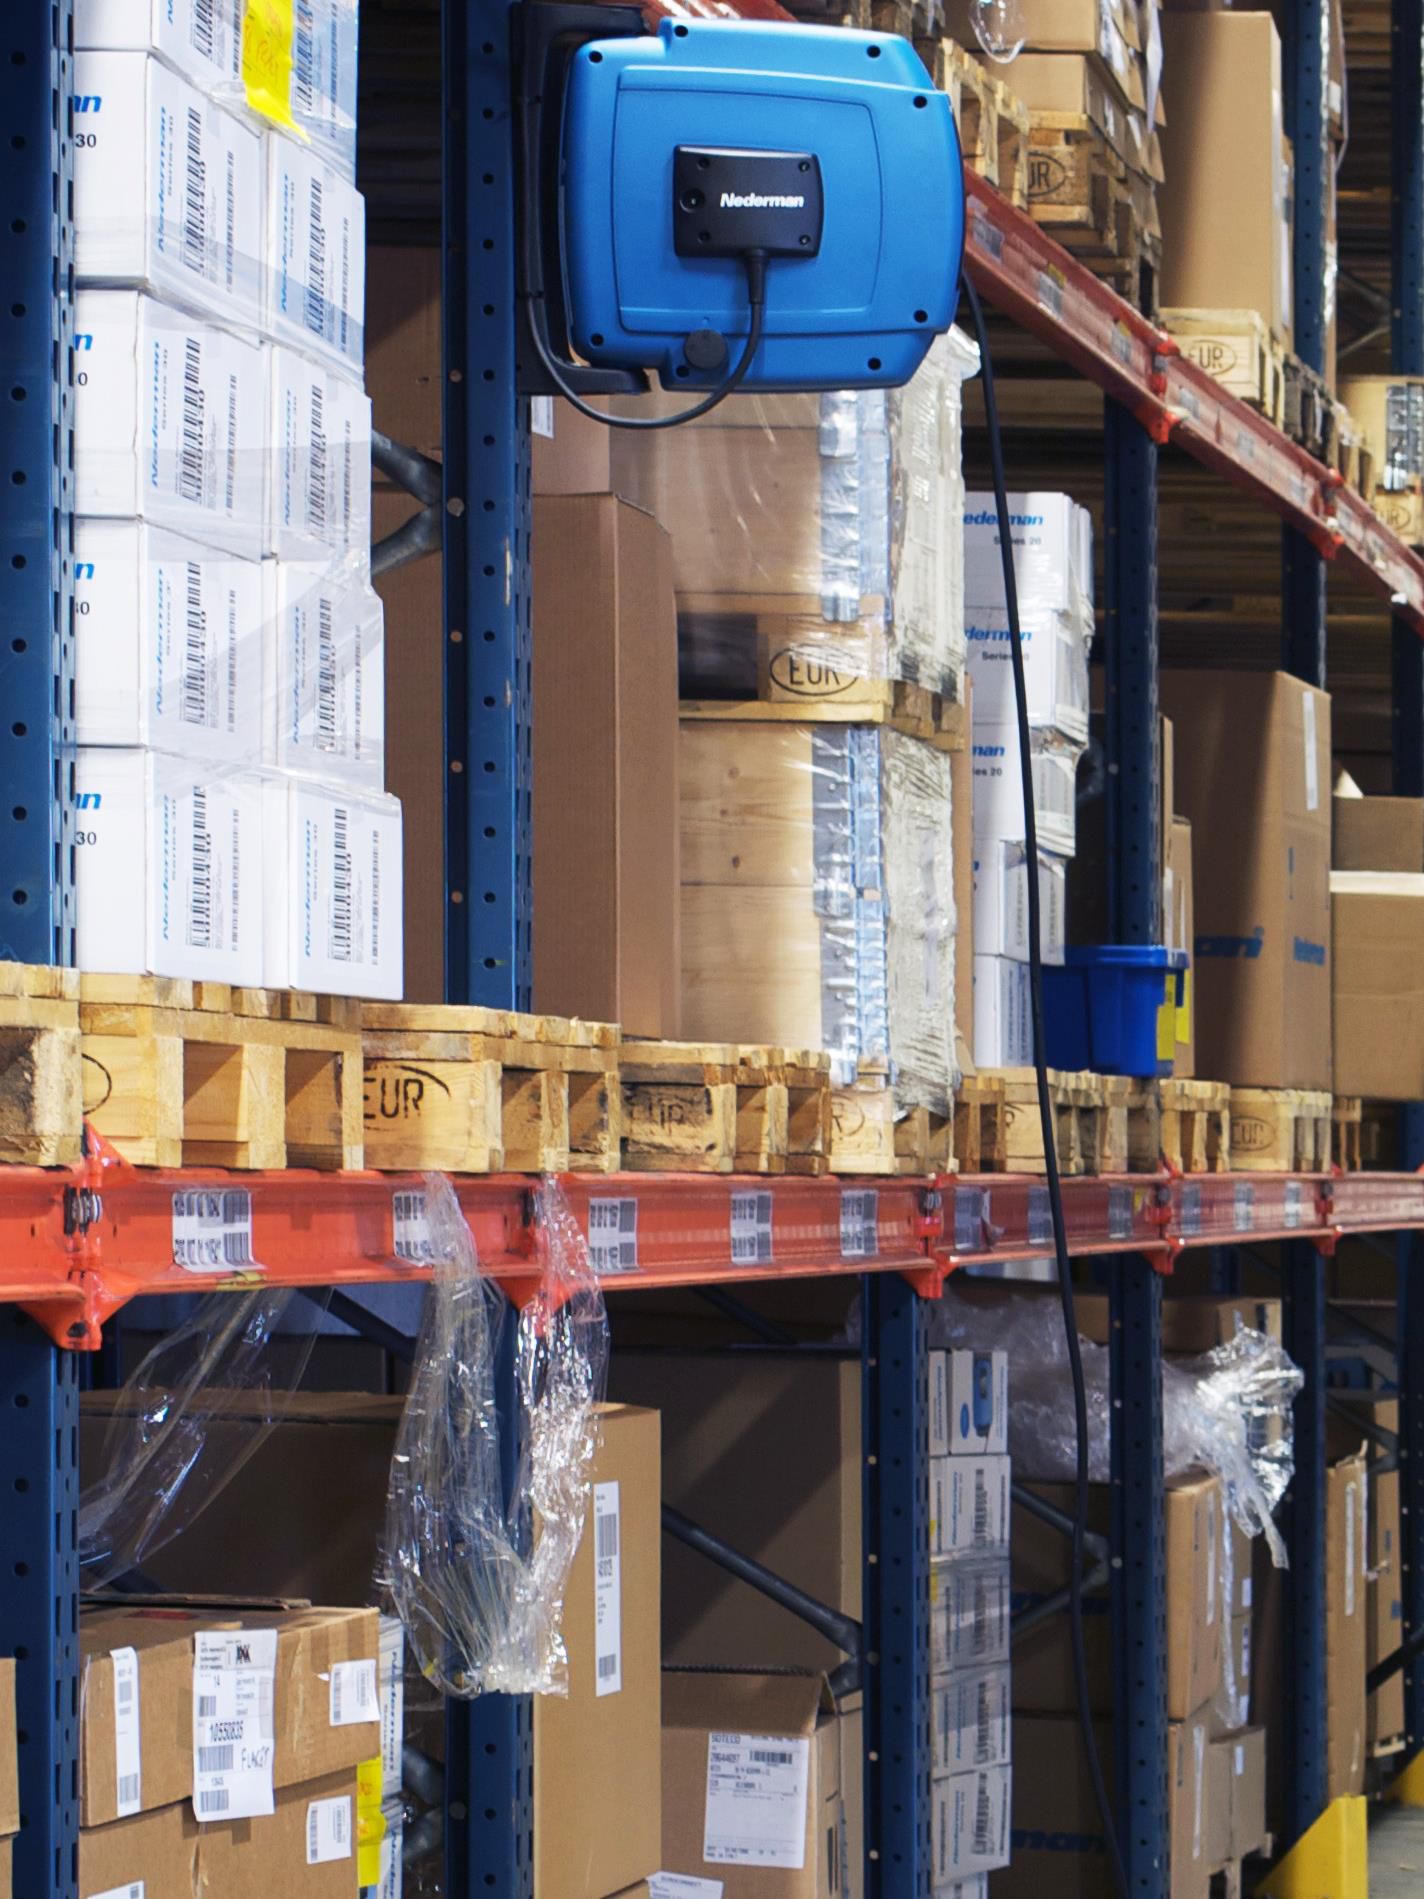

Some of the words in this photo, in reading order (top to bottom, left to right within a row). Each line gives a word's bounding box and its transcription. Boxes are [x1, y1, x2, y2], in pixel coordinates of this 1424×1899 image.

[157, 106, 167, 252] Nederman
[720, 192, 804, 208] Nederman
[1028, 161, 1051, 188] UR
[151, 341, 160, 489] Nederman
[963, 511, 1044, 525] edeman
[155, 568, 164, 715] Nederman
[965, 626, 1033, 641] dermn
[991, 767, 1003, 777] 20
[161, 794, 170, 941] Nederman
[303, 818, 313, 958] Nederman
